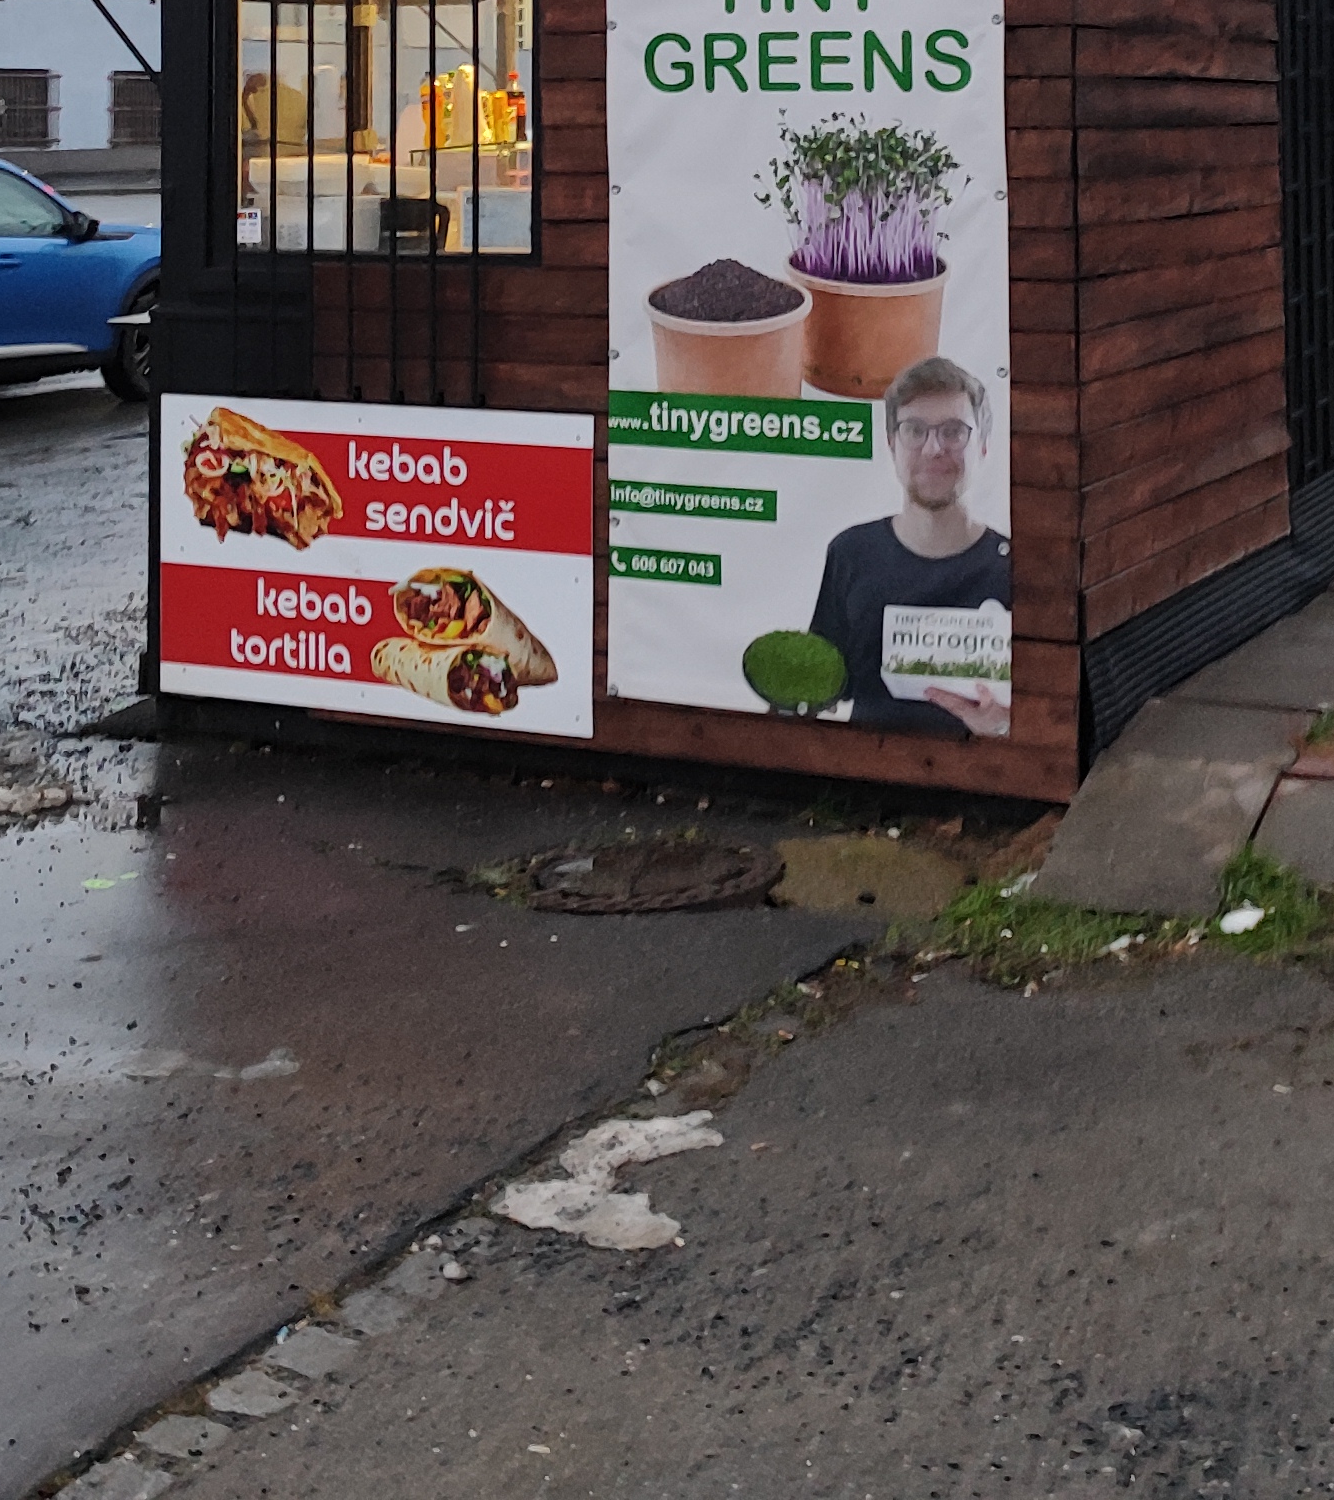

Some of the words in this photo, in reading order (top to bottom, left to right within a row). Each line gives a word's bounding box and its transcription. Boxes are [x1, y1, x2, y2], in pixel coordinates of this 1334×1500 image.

[644, 28, 972, 93] GREENS
[608, 401, 864, 442] www.tinygreens.cz
[348, 440, 468, 486] kebab
[366, 497, 515, 541] sendvič
[257, 576, 373, 626] kebab
[230, 628, 352, 674] tortilla
